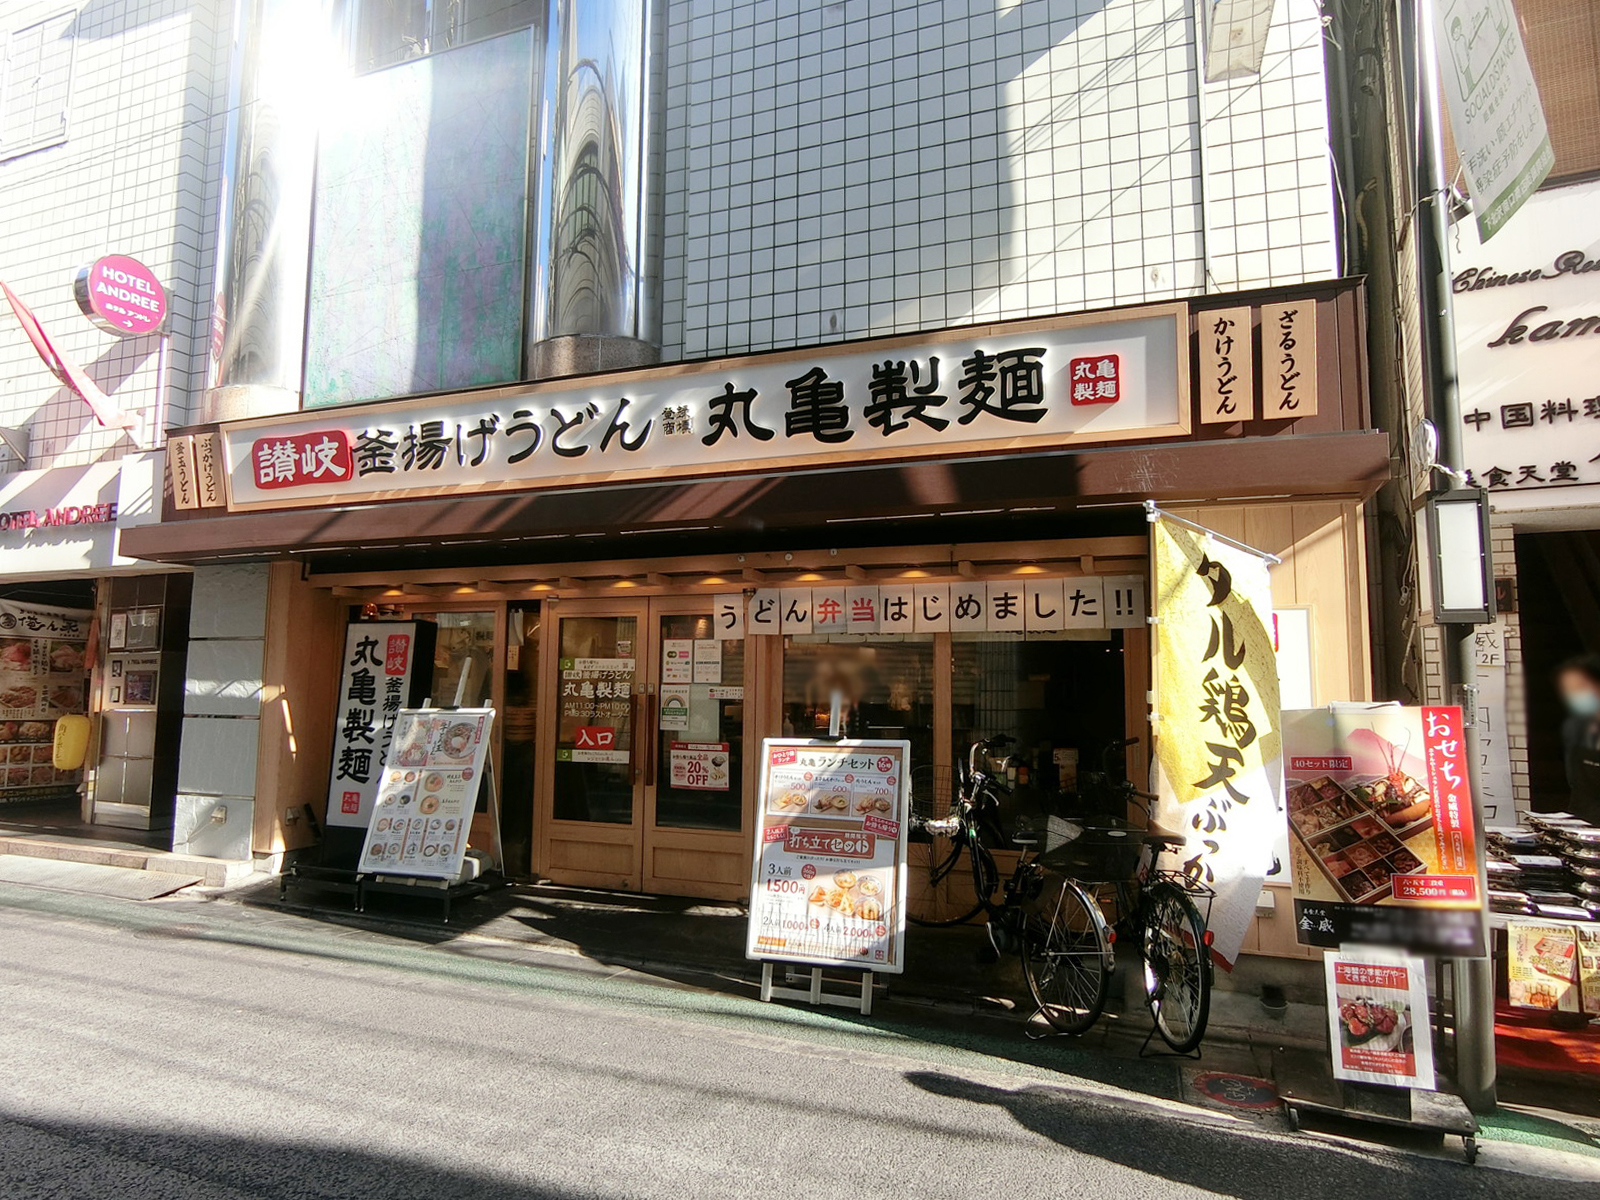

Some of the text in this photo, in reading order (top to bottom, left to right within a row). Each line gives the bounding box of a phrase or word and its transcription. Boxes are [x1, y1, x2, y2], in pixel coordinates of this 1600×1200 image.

[103, 266, 155, 295] HOTEL
[1452, 266, 1542, 294] Chinese
[96, 281, 160, 312] ANDREE
[105, 302, 126, 315] ホテル
[1074, 360, 1117, 381] 丸亀
[1213, 317, 1238, 415] かけうどん
[1278, 309, 1301, 411] ざるうどん
[701, 346, 1049, 446] 丸亀製麺
[1073, 381, 1117, 402] 製麺
[258, 397, 652, 484] 讃岐 釜揚げうどん
[201, 438, 217, 502] ぶっかけうどん
[43, 502, 118, 527] ANDREE
[720, 588, 1132, 630] うどん弁当はじめました!!
[1481, 653, 1500, 665] 2F
[563, 681, 631, 699] 丸亀製麺
[336, 635, 384, 784] 丸亀製麺
[376, 638, 408, 784] 讃岐 釜揚げうど
[576, 729, 613, 747] 入口
[1425, 710, 1461, 790] おせち
[687, 761, 709, 774] 20%
[799, 756, 875, 770] 丸亀ランチセット
[687, 774, 709, 786] OFF
[790, 836, 870, 853] 打ち立てセット
[768, 863, 792, 876] 3人前
